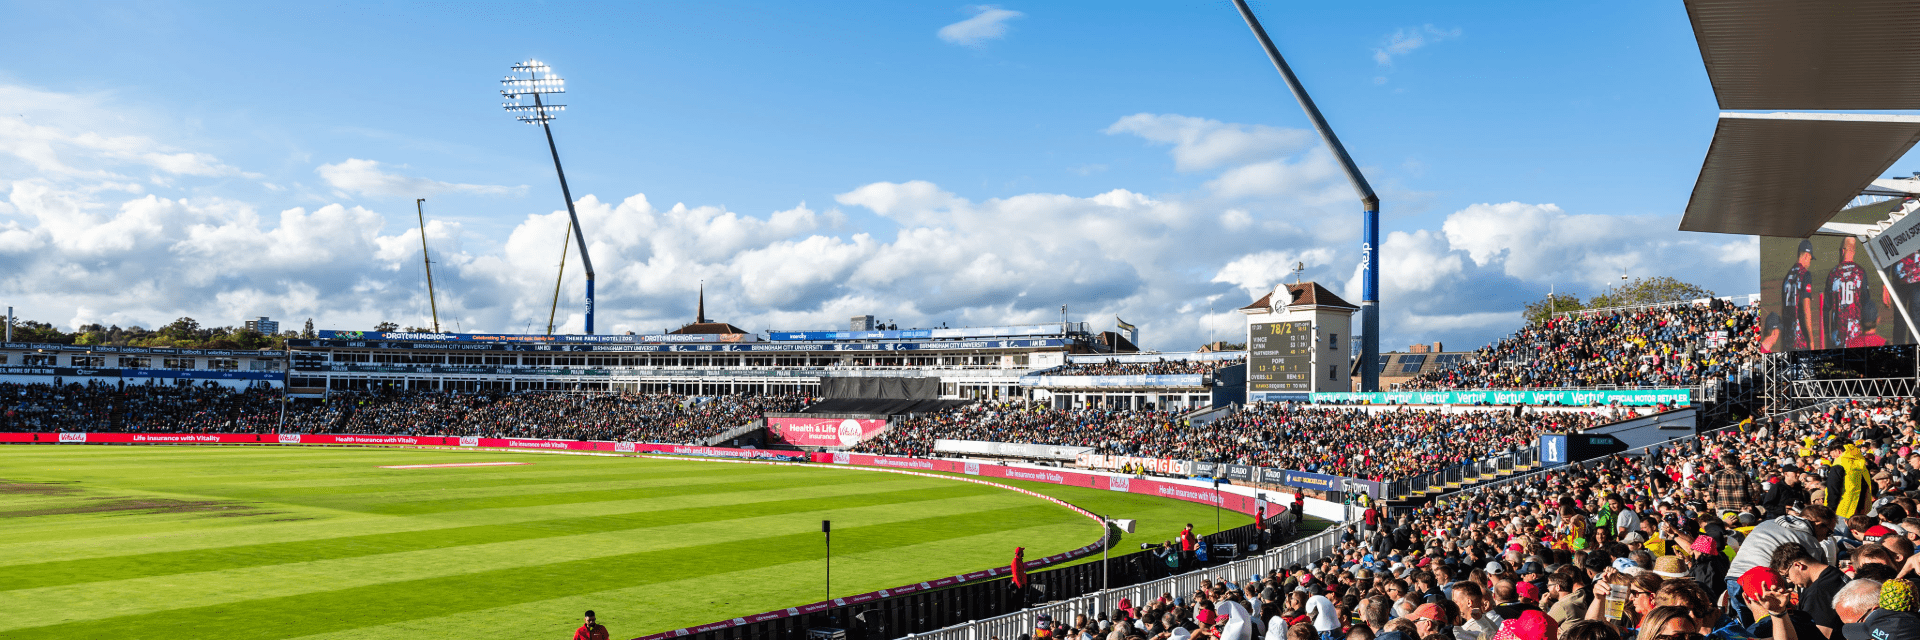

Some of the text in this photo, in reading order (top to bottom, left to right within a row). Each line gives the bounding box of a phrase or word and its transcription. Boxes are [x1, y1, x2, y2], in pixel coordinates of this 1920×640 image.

[1363, 242, 1372, 271] drax
[1841, 281, 1854, 305] 16
[1271, 322, 1292, 335] 78/2
[1313, 394, 1336, 403] Vertu
[1348, 393, 1370, 402] Vertu
[1383, 393, 1408, 403] Vertu
[1420, 393, 1445, 403] Vertu
[1457, 393, 1482, 403] Vertu
[1494, 393, 1520, 403] Vertu
[1533, 392, 1559, 403] Vertu
[1572, 392, 1600, 403] Vertu
[790, 424, 815, 432] Health
[822, 424, 836, 433] Life
[840, 425, 862, 438] Vitality
[461, 437, 478, 446] Vitality
[918, 461, 933, 470] Vitality
[1091, 456, 1100, 466] IG
[1158, 460, 1168, 471] IG
[1172, 461, 1180, 472] IG
[1046, 473, 1064, 484] Vitality
[1110, 476, 1129, 492] Vitality
[1159, 486, 1175, 495] Health
[1176, 487, 1198, 499] insurance
[1198, 490, 1209, 501] with
